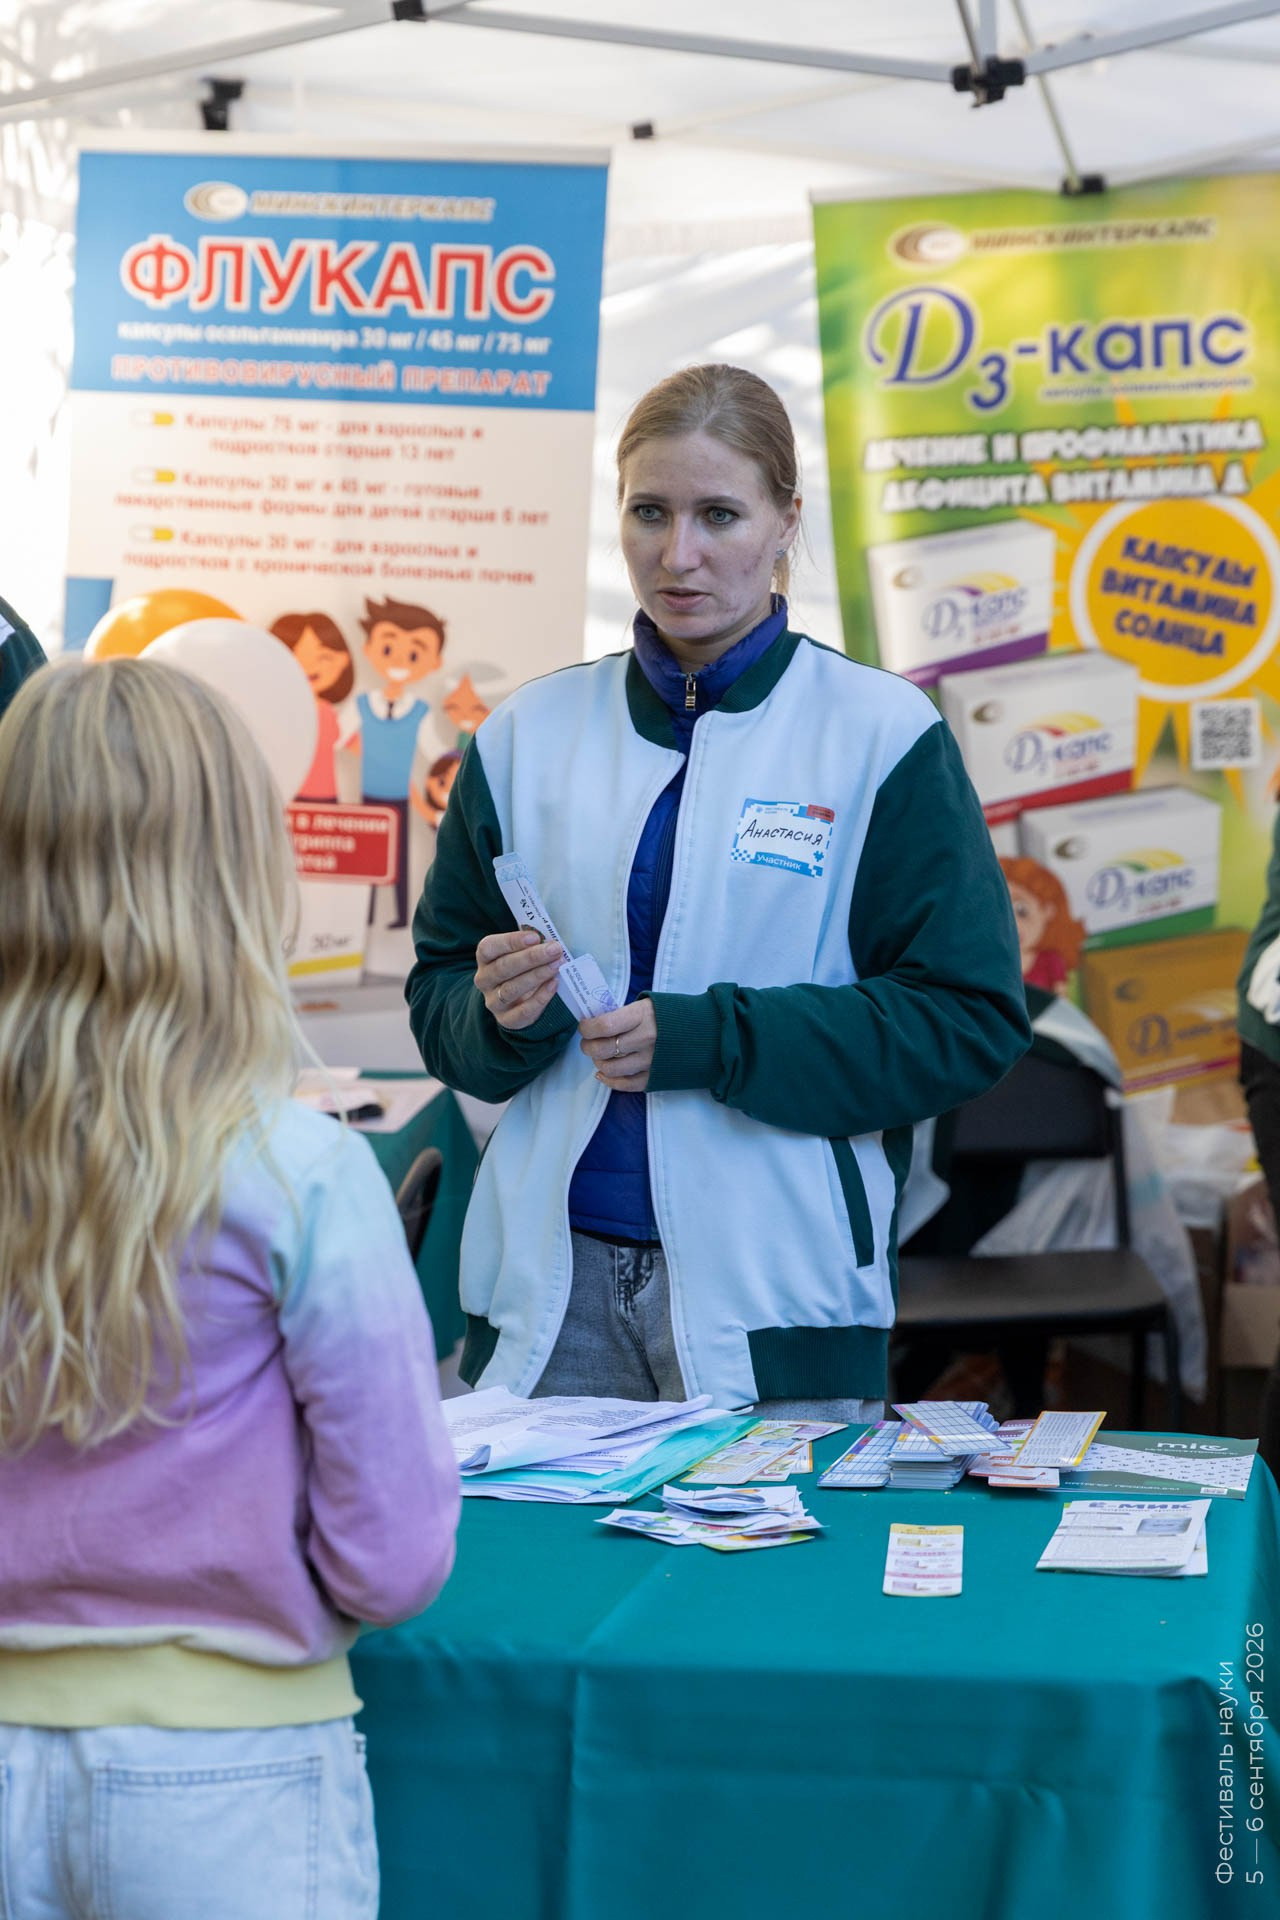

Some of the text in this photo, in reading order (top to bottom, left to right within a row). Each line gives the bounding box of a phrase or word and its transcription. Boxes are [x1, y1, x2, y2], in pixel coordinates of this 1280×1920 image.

[121, 234, 556, 323] ФЛУКАПС
[111, 355, 551, 397] ПРОТИВОВИРУСНЫЙ ПРЕПАРАТ
[865, 434, 988, 470] ЛЕЧЕНИЕ
[1121, 534, 1257, 587] КАПСУЛЫ
[1101, 567, 1256, 627] ВИТАМИНА
[1115, 608, 1225, 657] СОЛНЦА
